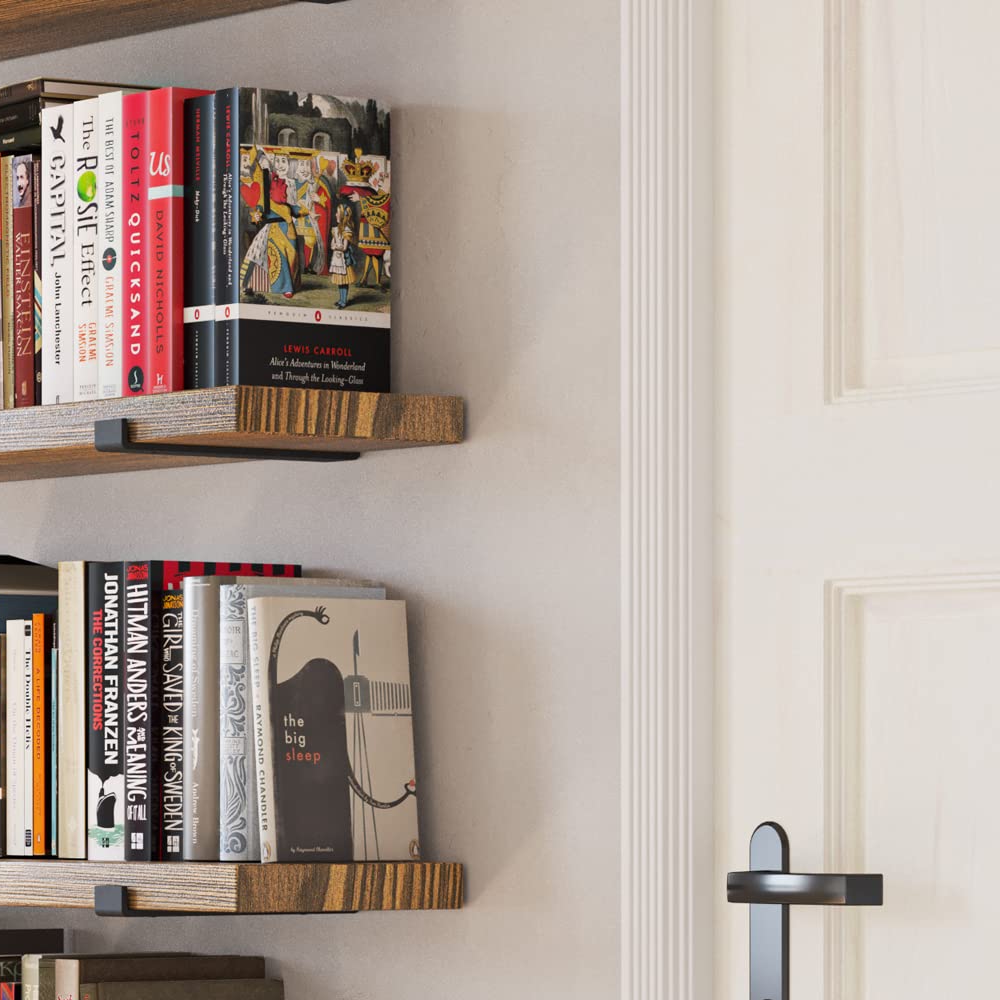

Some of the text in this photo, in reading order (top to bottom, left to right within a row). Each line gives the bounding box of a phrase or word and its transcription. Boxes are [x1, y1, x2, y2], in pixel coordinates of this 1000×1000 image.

[82, 116, 94, 150] The
[104, 118, 113, 136] THE
[104, 139, 113, 161] BEST
[104, 165, 113, 175] OF
[50, 156, 66, 267] CAPITAL
[104, 181, 113, 210] ADAM
[104, 212, 114, 242] SHARP
[128, 131, 141, 355] TOLTZ QUICKSAND
[54, 272, 62, 300] John
[80, 243, 95, 307] Effect
[155, 209, 164, 354] DAVID NICHOLLS
[21, 232, 32, 357] EINSTEIN
[105, 276, 114, 319] GRAEME
[88, 322, 96, 361] GRAEME
[284, 345, 352, 357] LEWIS CARROLL
[272, 371, 364, 387] and Through the Looking-Glass
[290, 358, 322, 368] Adventures
[331, 360, 366, 371] Wonderland
[93, 609, 102, 730] THE CORRECTIONS
[104, 572, 118, 765] JONATHAN FRANZEN
[126, 584, 148, 802] HITMAN ANDERS MEANING
[163, 612, 183, 831] GIRL SAVED KING OF SWEDEN
[284, 713, 304, 727] the
[284, 731, 306, 747] big
[285, 748, 321, 764] sleep
[256, 704, 268, 832] RAYMOND CHANDLER
[191, 781, 199, 844] Andrew Brown
